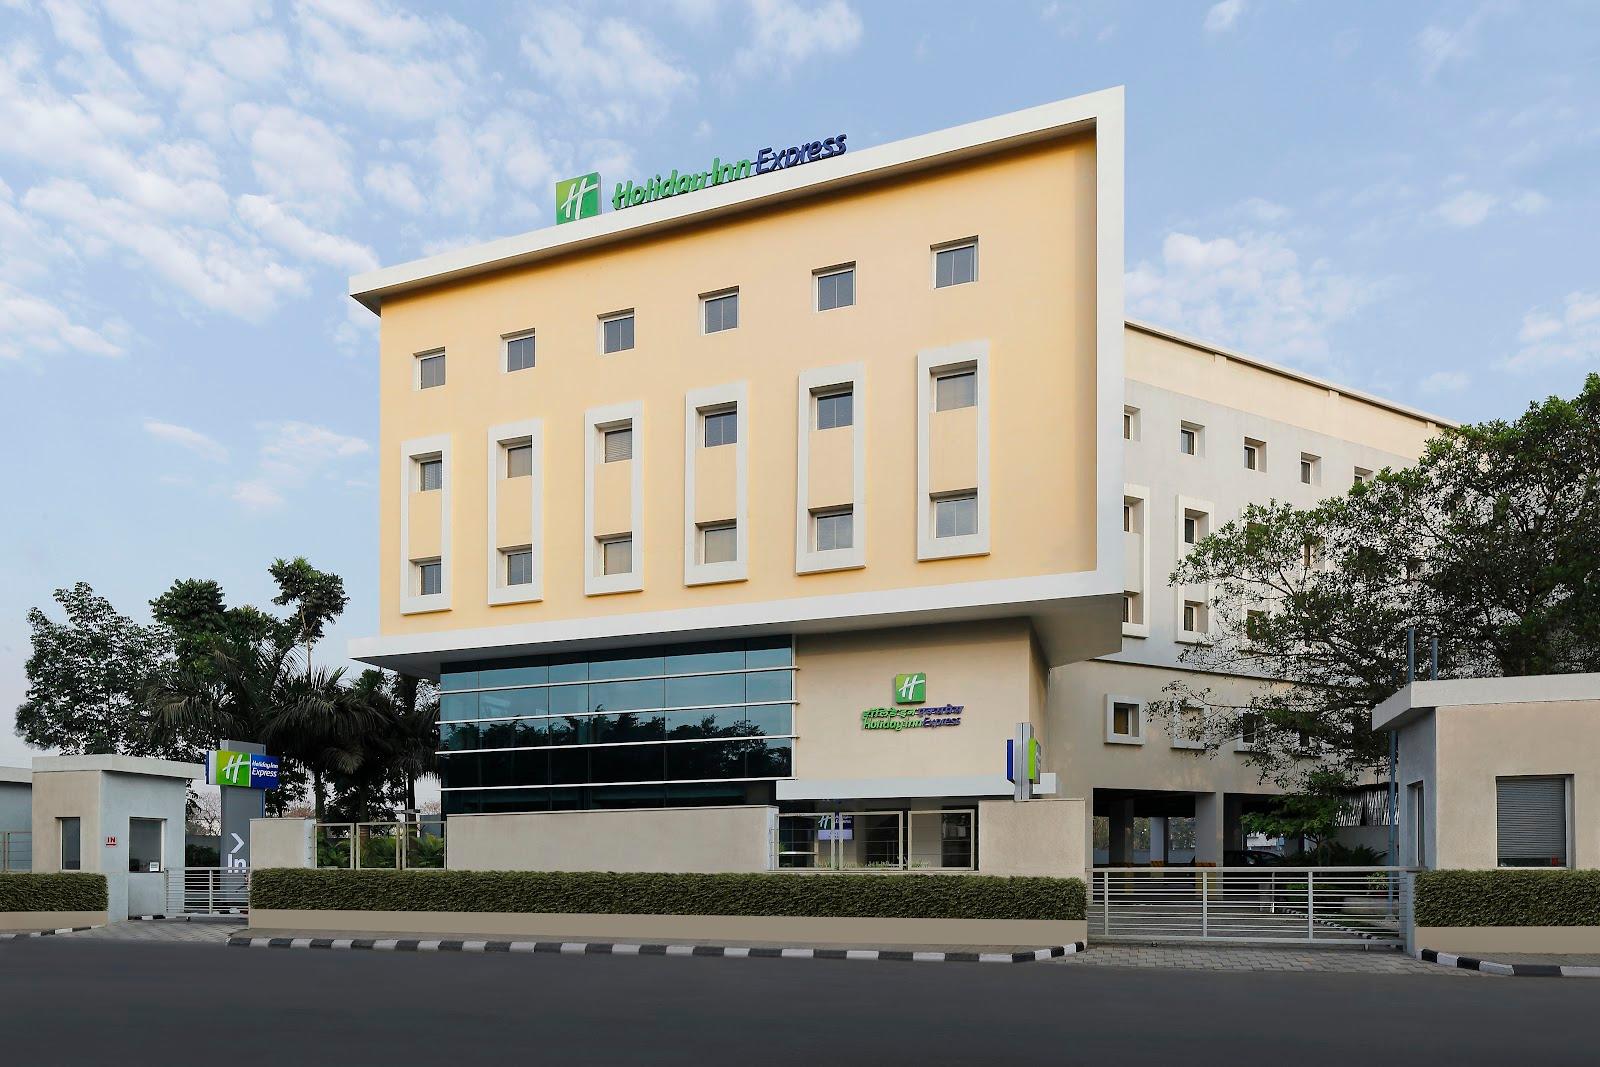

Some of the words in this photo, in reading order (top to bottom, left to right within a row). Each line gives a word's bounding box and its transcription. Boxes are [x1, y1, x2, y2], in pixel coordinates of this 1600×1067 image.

[612, 169, 708, 210] Holiday
[711, 157, 752, 186] Inn
[755, 134, 847, 175] Express
[251, 767, 277, 777] Express
[228, 853, 247, 874] In
